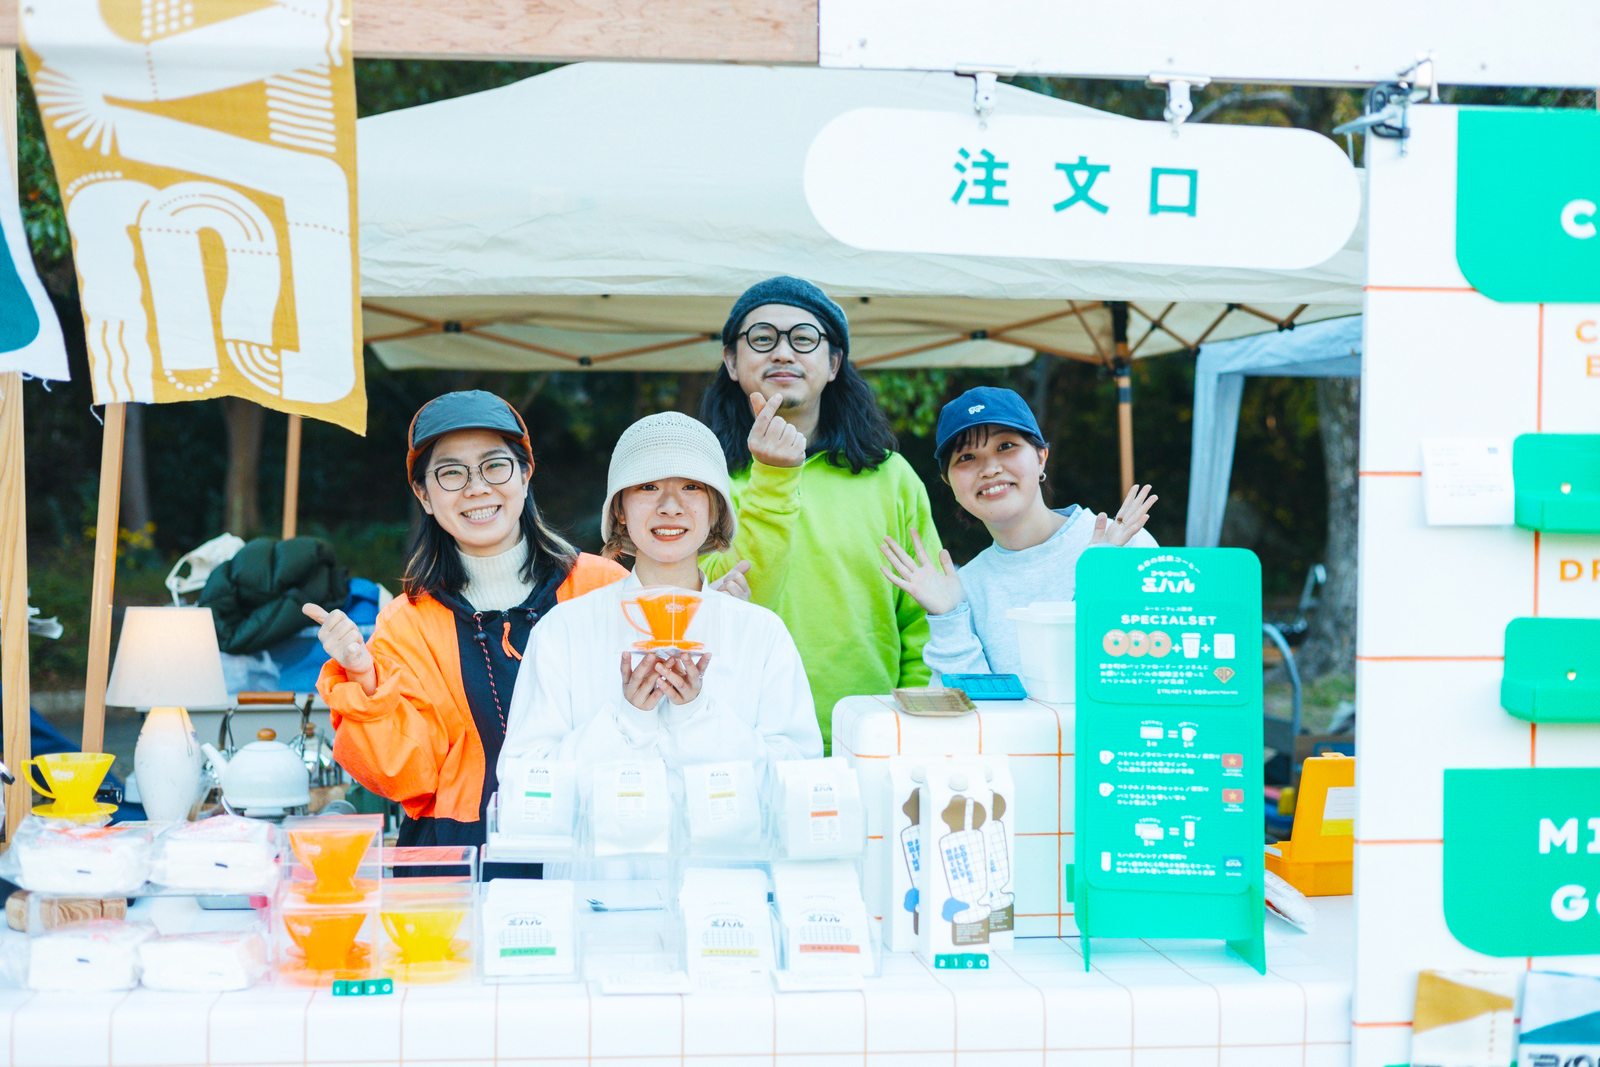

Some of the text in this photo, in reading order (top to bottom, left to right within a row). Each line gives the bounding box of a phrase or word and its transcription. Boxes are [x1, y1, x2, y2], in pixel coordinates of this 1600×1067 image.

[950, 147, 1199, 217] 注文口
[1121, 614, 1217, 626] SPECIALSET
[1550, 884, 1600, 922] G
